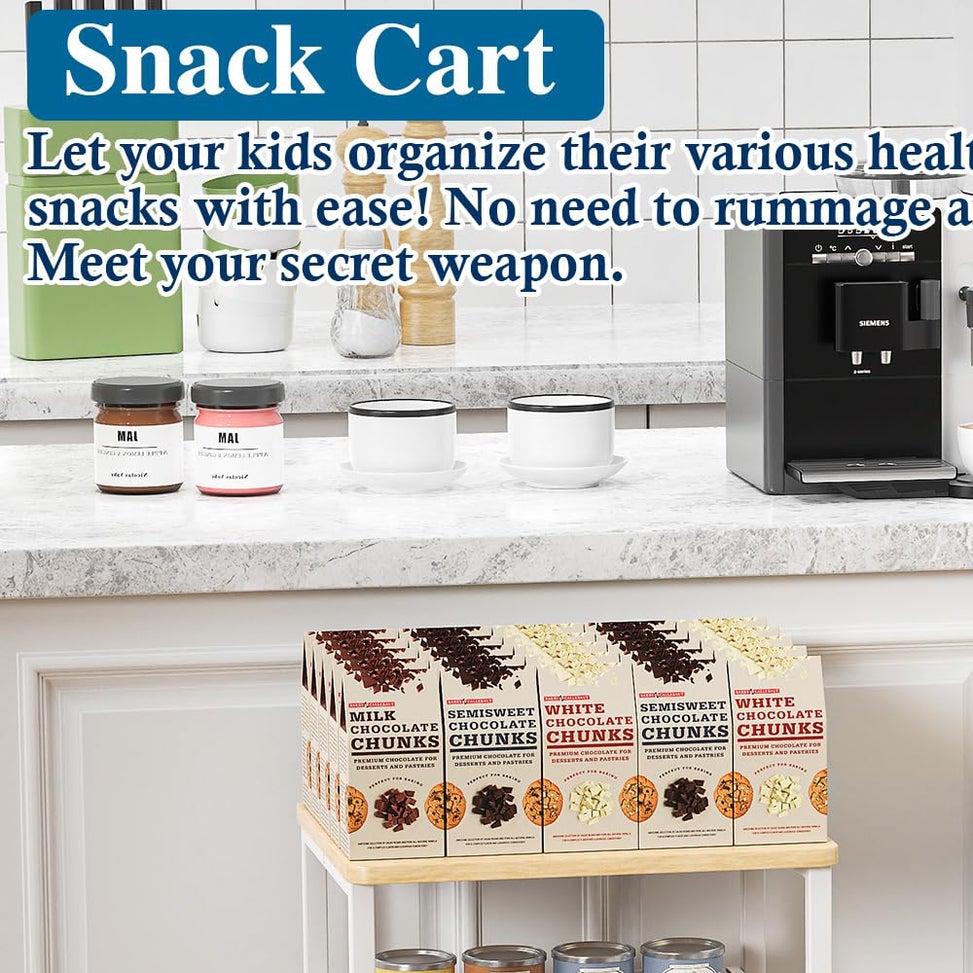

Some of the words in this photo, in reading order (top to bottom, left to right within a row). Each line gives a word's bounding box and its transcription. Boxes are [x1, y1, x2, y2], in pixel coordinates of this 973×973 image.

[640, 701, 726, 712] SEMISWEET
[735, 697, 795, 708] WHITE
[448, 708, 535, 719] SEMISWEET
[545, 703, 605, 715] WHITE
[736, 709, 823, 721] CHOCOLATE
[350, 710, 396, 722] MILK
[546, 716, 633, 728] CHOCOLATE
[641, 713, 728, 724] CHOCOLATE
[350, 723, 439, 734] CHOCOLATE
[449, 720, 536, 731] CHOCOLATE
[737, 722, 824, 737] CHUNKS
[546, 728, 634, 743] CHUNKS
[642, 725, 729, 740] CHUNKS
[350, 735, 440, 750] CHUNKS
[450, 732, 537, 747] CHUNKS
